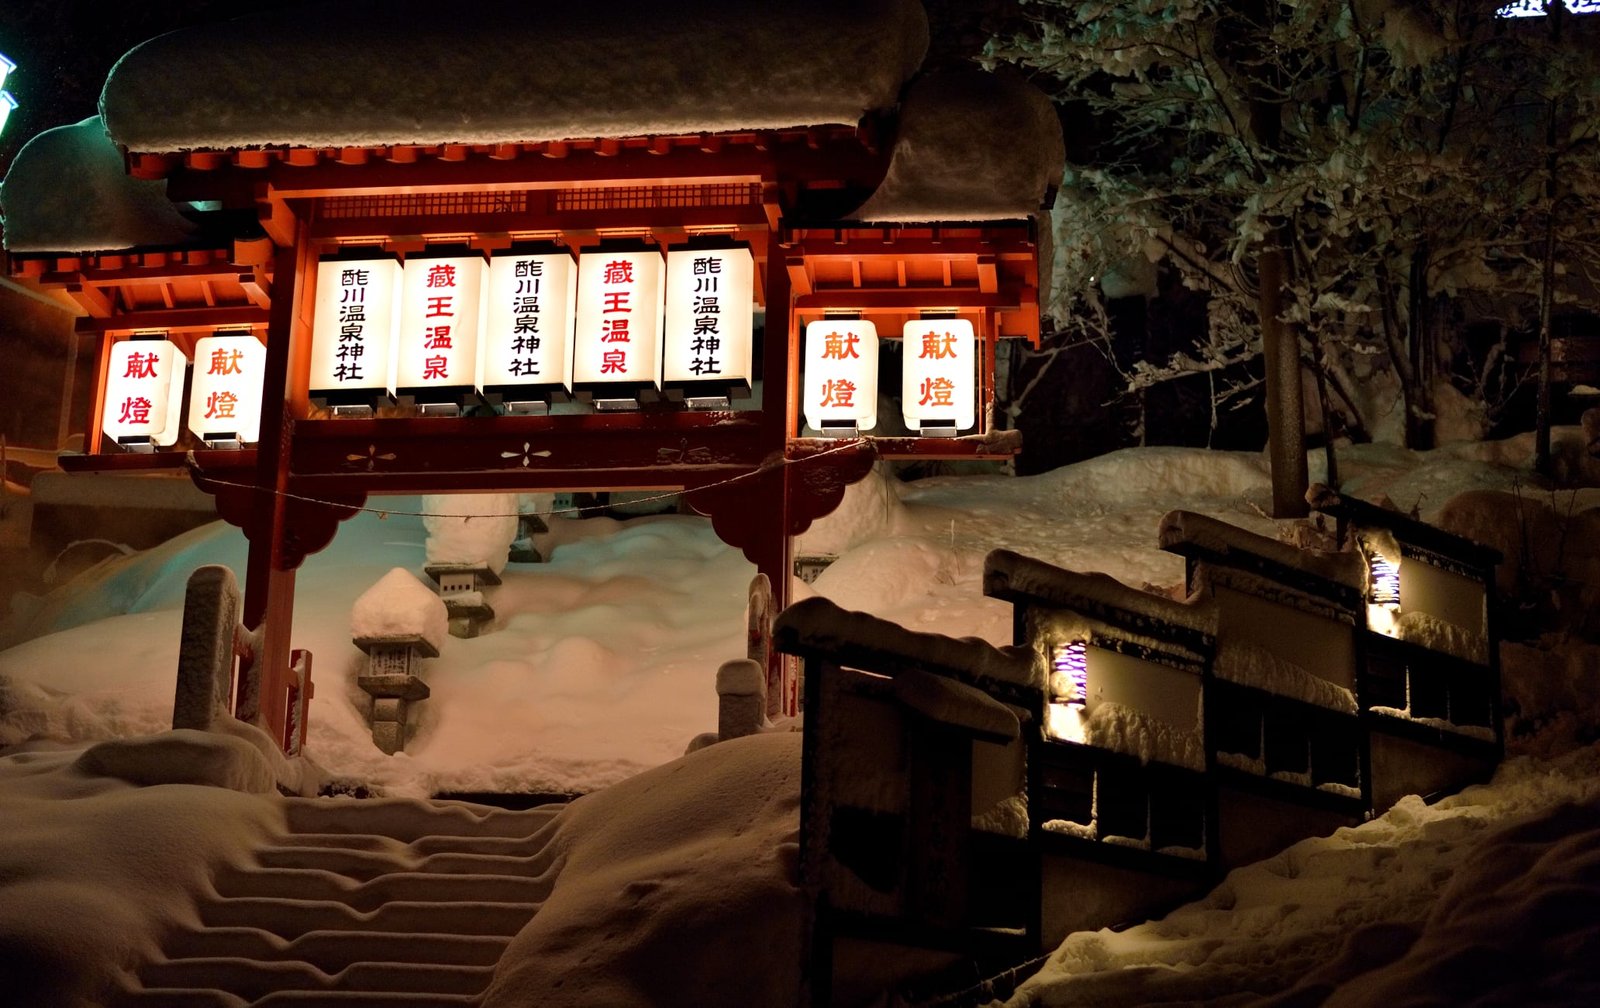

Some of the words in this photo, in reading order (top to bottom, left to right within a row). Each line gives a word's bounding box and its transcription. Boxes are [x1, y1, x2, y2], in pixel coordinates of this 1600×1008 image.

[333, 269, 370, 381] 酢川温泉神社
[422, 264, 457, 379] 蔵王温泉
[508, 259, 545, 377] 酢川温泉神社
[600, 259, 634, 374] 蔵王温泉
[689, 256, 722, 376] 酢川温泉神社
[819, 331, 860, 407] 献燈
[918, 330, 957, 407] 献燈
[118, 352, 159, 424] 献燈
[204, 348, 244, 419] 献燈
